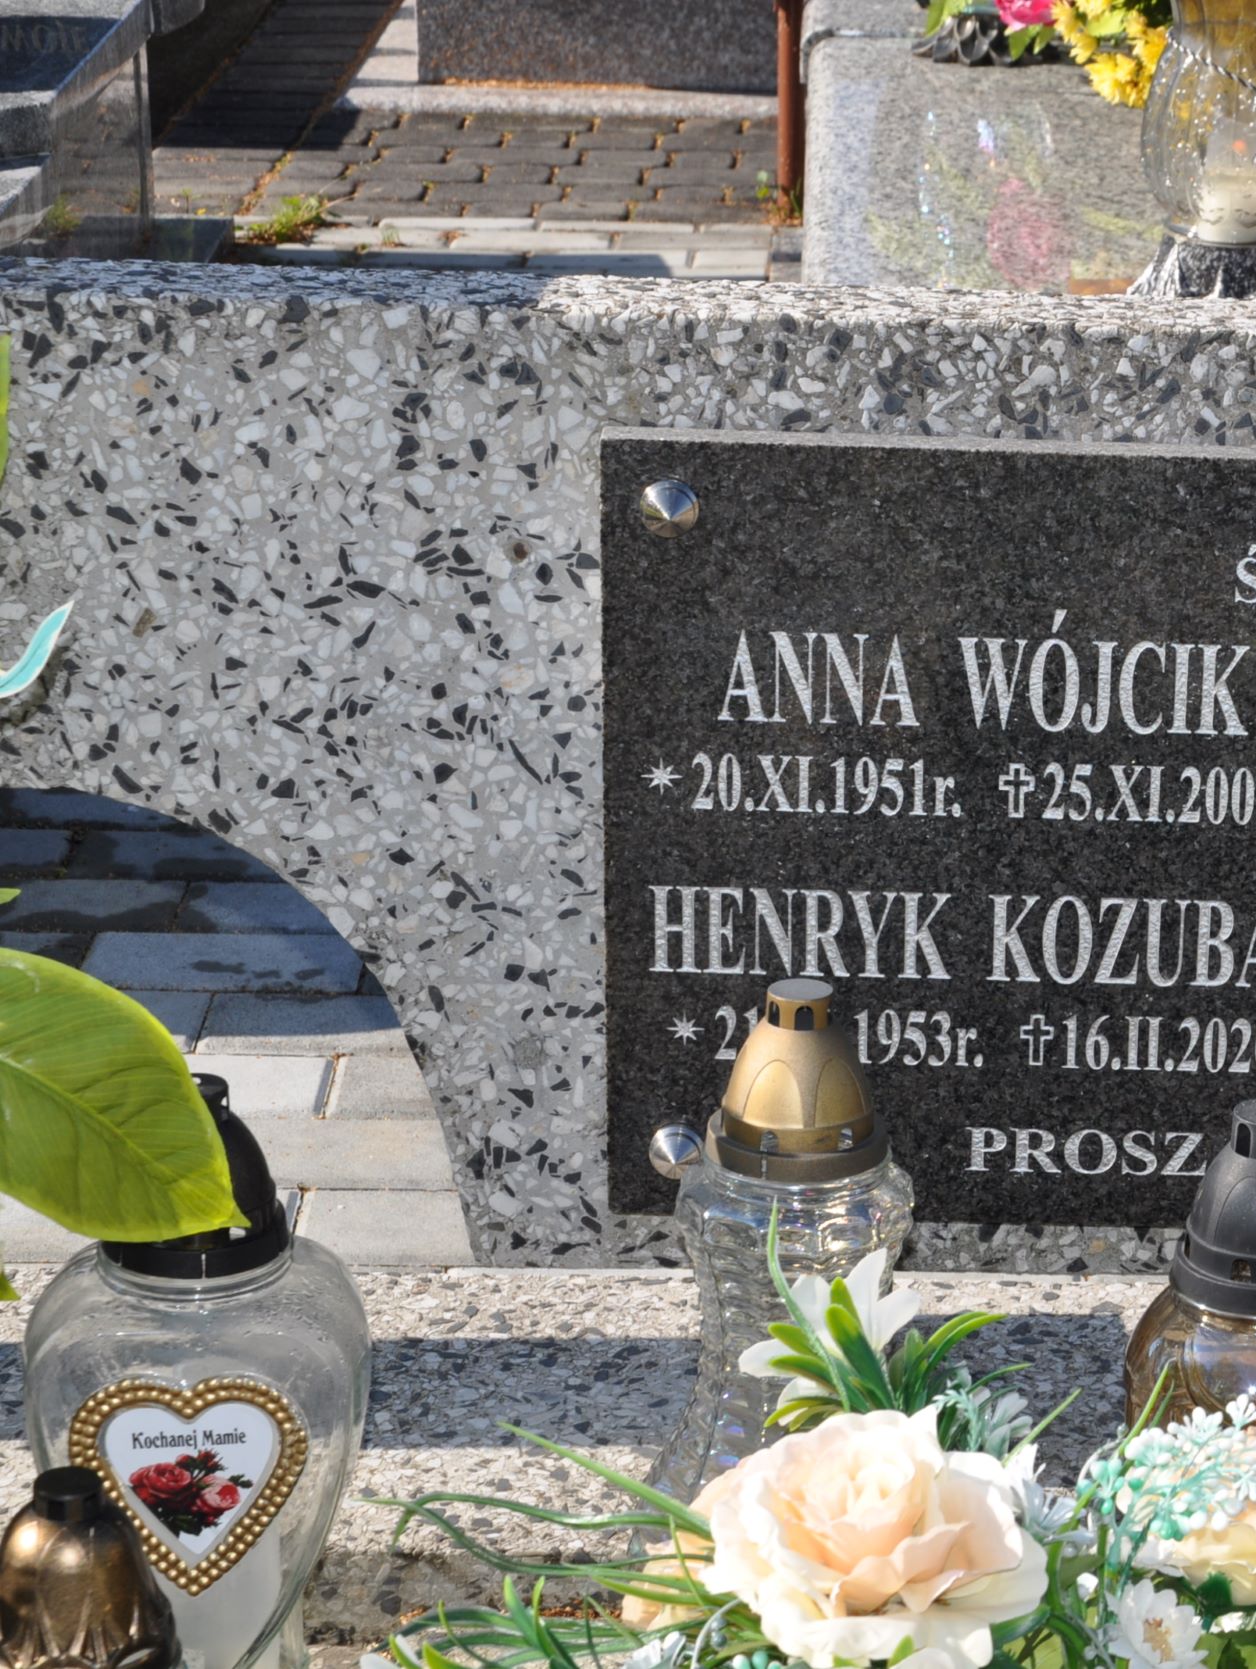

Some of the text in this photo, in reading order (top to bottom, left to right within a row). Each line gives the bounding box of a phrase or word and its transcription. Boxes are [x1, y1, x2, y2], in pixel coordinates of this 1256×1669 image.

[718, 609, 1250, 736] ANNA WÓJCIK
[691, 752, 962, 818] 20.XI.1951r.
[649, 885, 951, 979] HENRYK
[965, 1126, 1208, 1176] PROSZ
[131, 1428, 247, 1449] Kochanej Mamie
